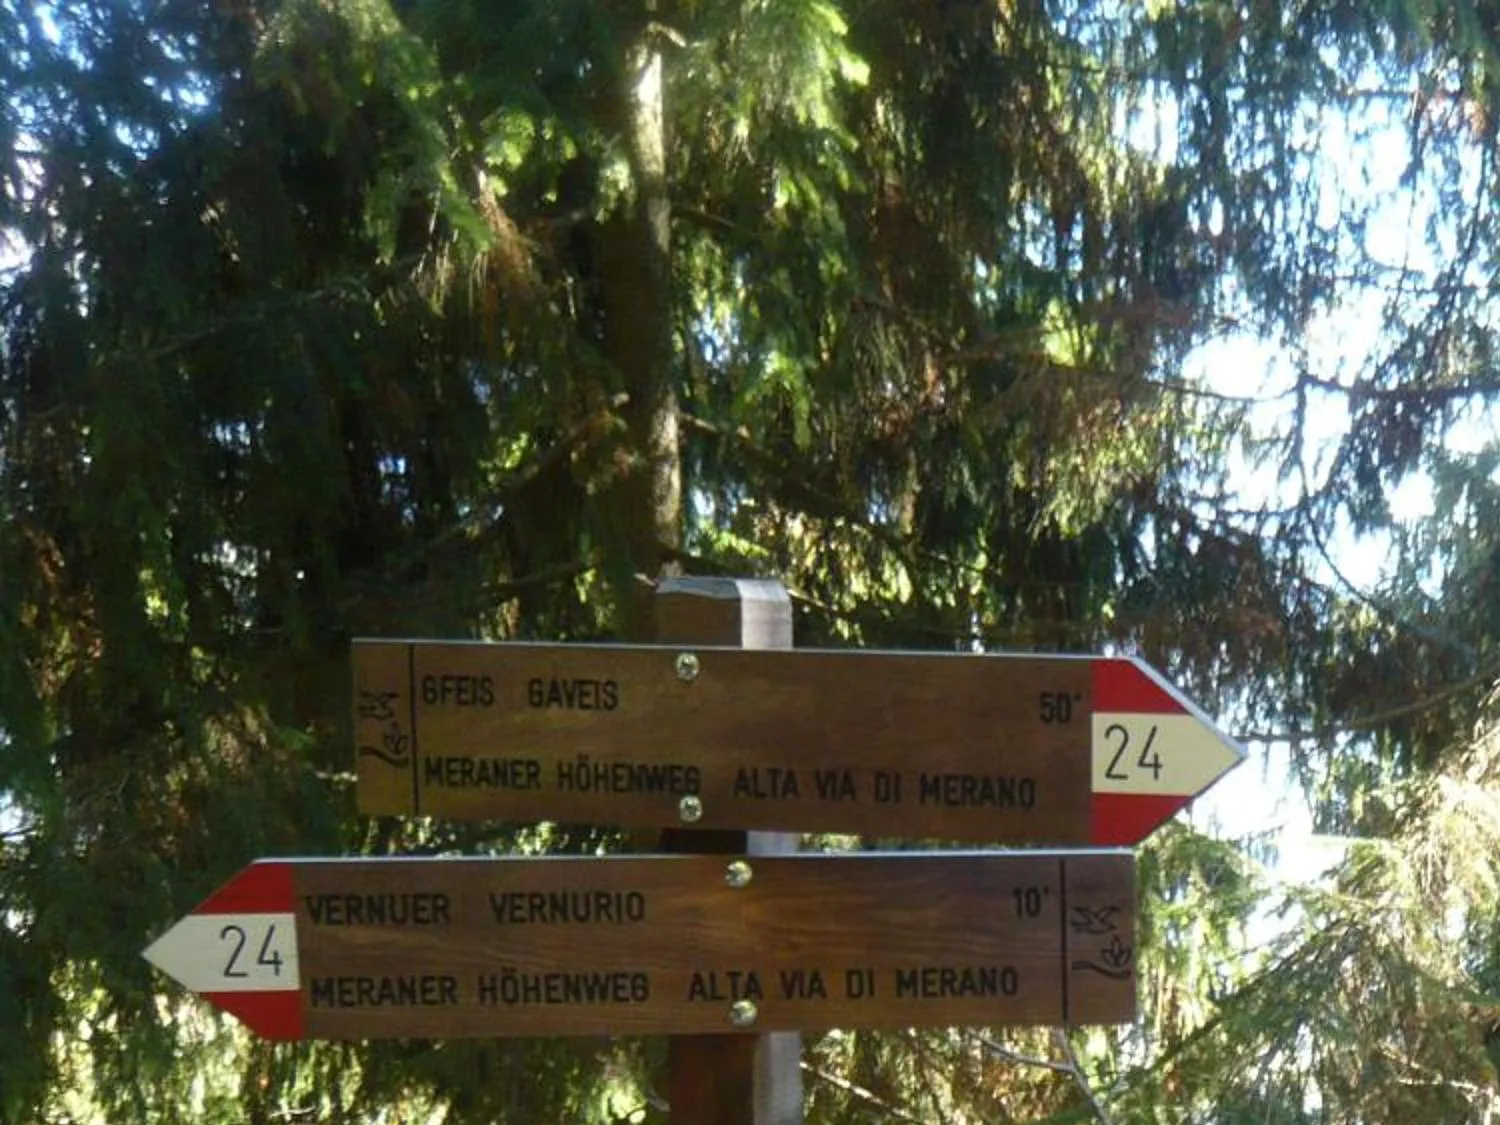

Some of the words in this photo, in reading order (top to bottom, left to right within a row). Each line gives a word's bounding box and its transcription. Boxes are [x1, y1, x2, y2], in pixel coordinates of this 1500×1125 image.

[421, 676, 495, 707] GFEIS
[528, 677, 619, 711] GAVEIS
[1104, 724, 1163, 781] 24
[425, 756, 541, 791] MERANER
[557, 754, 701, 796] HÖHENWEG
[734, 767, 798, 799] ALTA
[815, 769, 855, 801] VIA
[874, 772, 901, 803] DI
[920, 773, 1036, 808] MERANO
[305, 893, 451, 926] VERNUER
[490, 891, 646, 924] VERNURIO
[219, 923, 284, 978] 24
[311, 975, 458, 1008] MERANER
[477, 969, 650, 1006] HÖHENWEG
[688, 970, 763, 1001] ALTA
[780, 969, 827, 1000] VIA
[846, 968, 875, 999] DI
[896, 966, 1018, 999] MERANO
